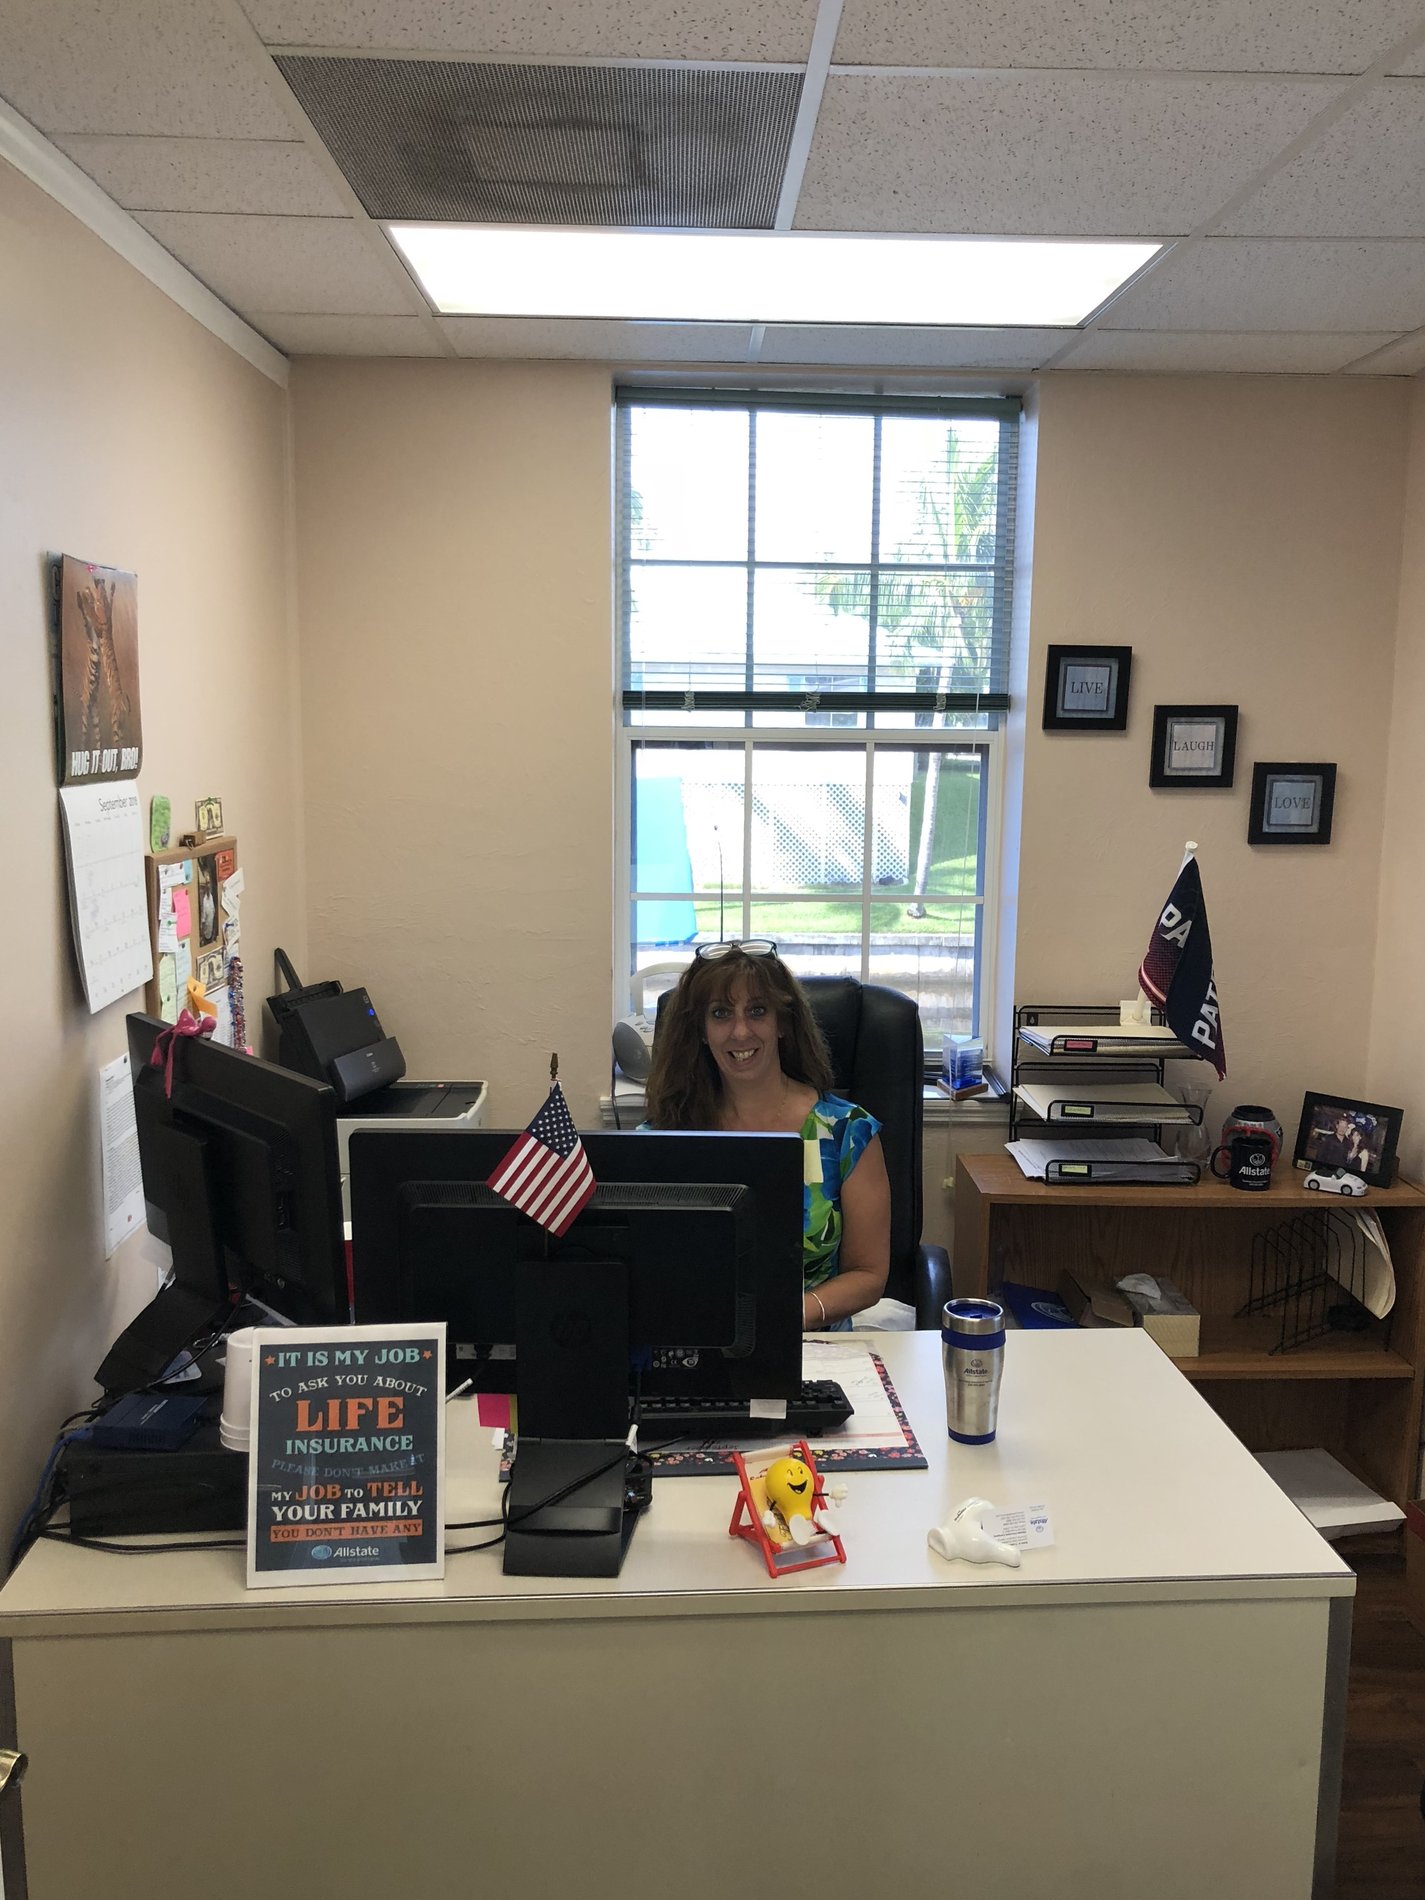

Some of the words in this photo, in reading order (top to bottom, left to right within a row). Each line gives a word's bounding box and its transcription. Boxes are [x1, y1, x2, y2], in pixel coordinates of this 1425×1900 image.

[1071, 681, 1103, 694] LIVE
[1173, 740, 1215, 751] LAUGH
[71, 750, 90, 777] HUG
[90, 749, 100, 774] IT
[101, 748, 119, 774] OUT,
[1274, 796, 1311, 809] LOVE
[1239, 1166, 1271, 1176] Allstate
[278, 1351, 301, 1368] IT
[307, 1350, 329, 1367] IS
[335, 1349, 370, 1366] MY
[375, 1347, 421, 1365] JOB
[963, 1367, 989, 1375] Allstate
[269, 1387, 292, 1403] TO
[298, 1376, 329, 1394] ASK
[335, 1374, 369, 1386] YOU
[373, 1375, 428, 1398] ABOUT
[295, 1396, 404, 1432] LIFE
[285, 1435, 414, 1455] INSURANCE
[271, 1458, 320, 1477] PLEASE
[368, 1458, 409, 1475] MAKE
[271, 1491, 292, 1501] MY
[296, 1483, 342, 1501] JOB
[345, 1488, 364, 1499] TO
[367, 1480, 424, 1498] TELL
[272, 1503, 335, 1522] YOUR
[340, 1500, 424, 1519] FAMILY
[272, 1528, 300, 1539] YOU
[306, 1526, 346, 1538] DON'T
[351, 1525, 388, 1537] HAVE
[392, 1522, 421, 1534] ANY
[333, 1545, 380, 1559] Allstate
